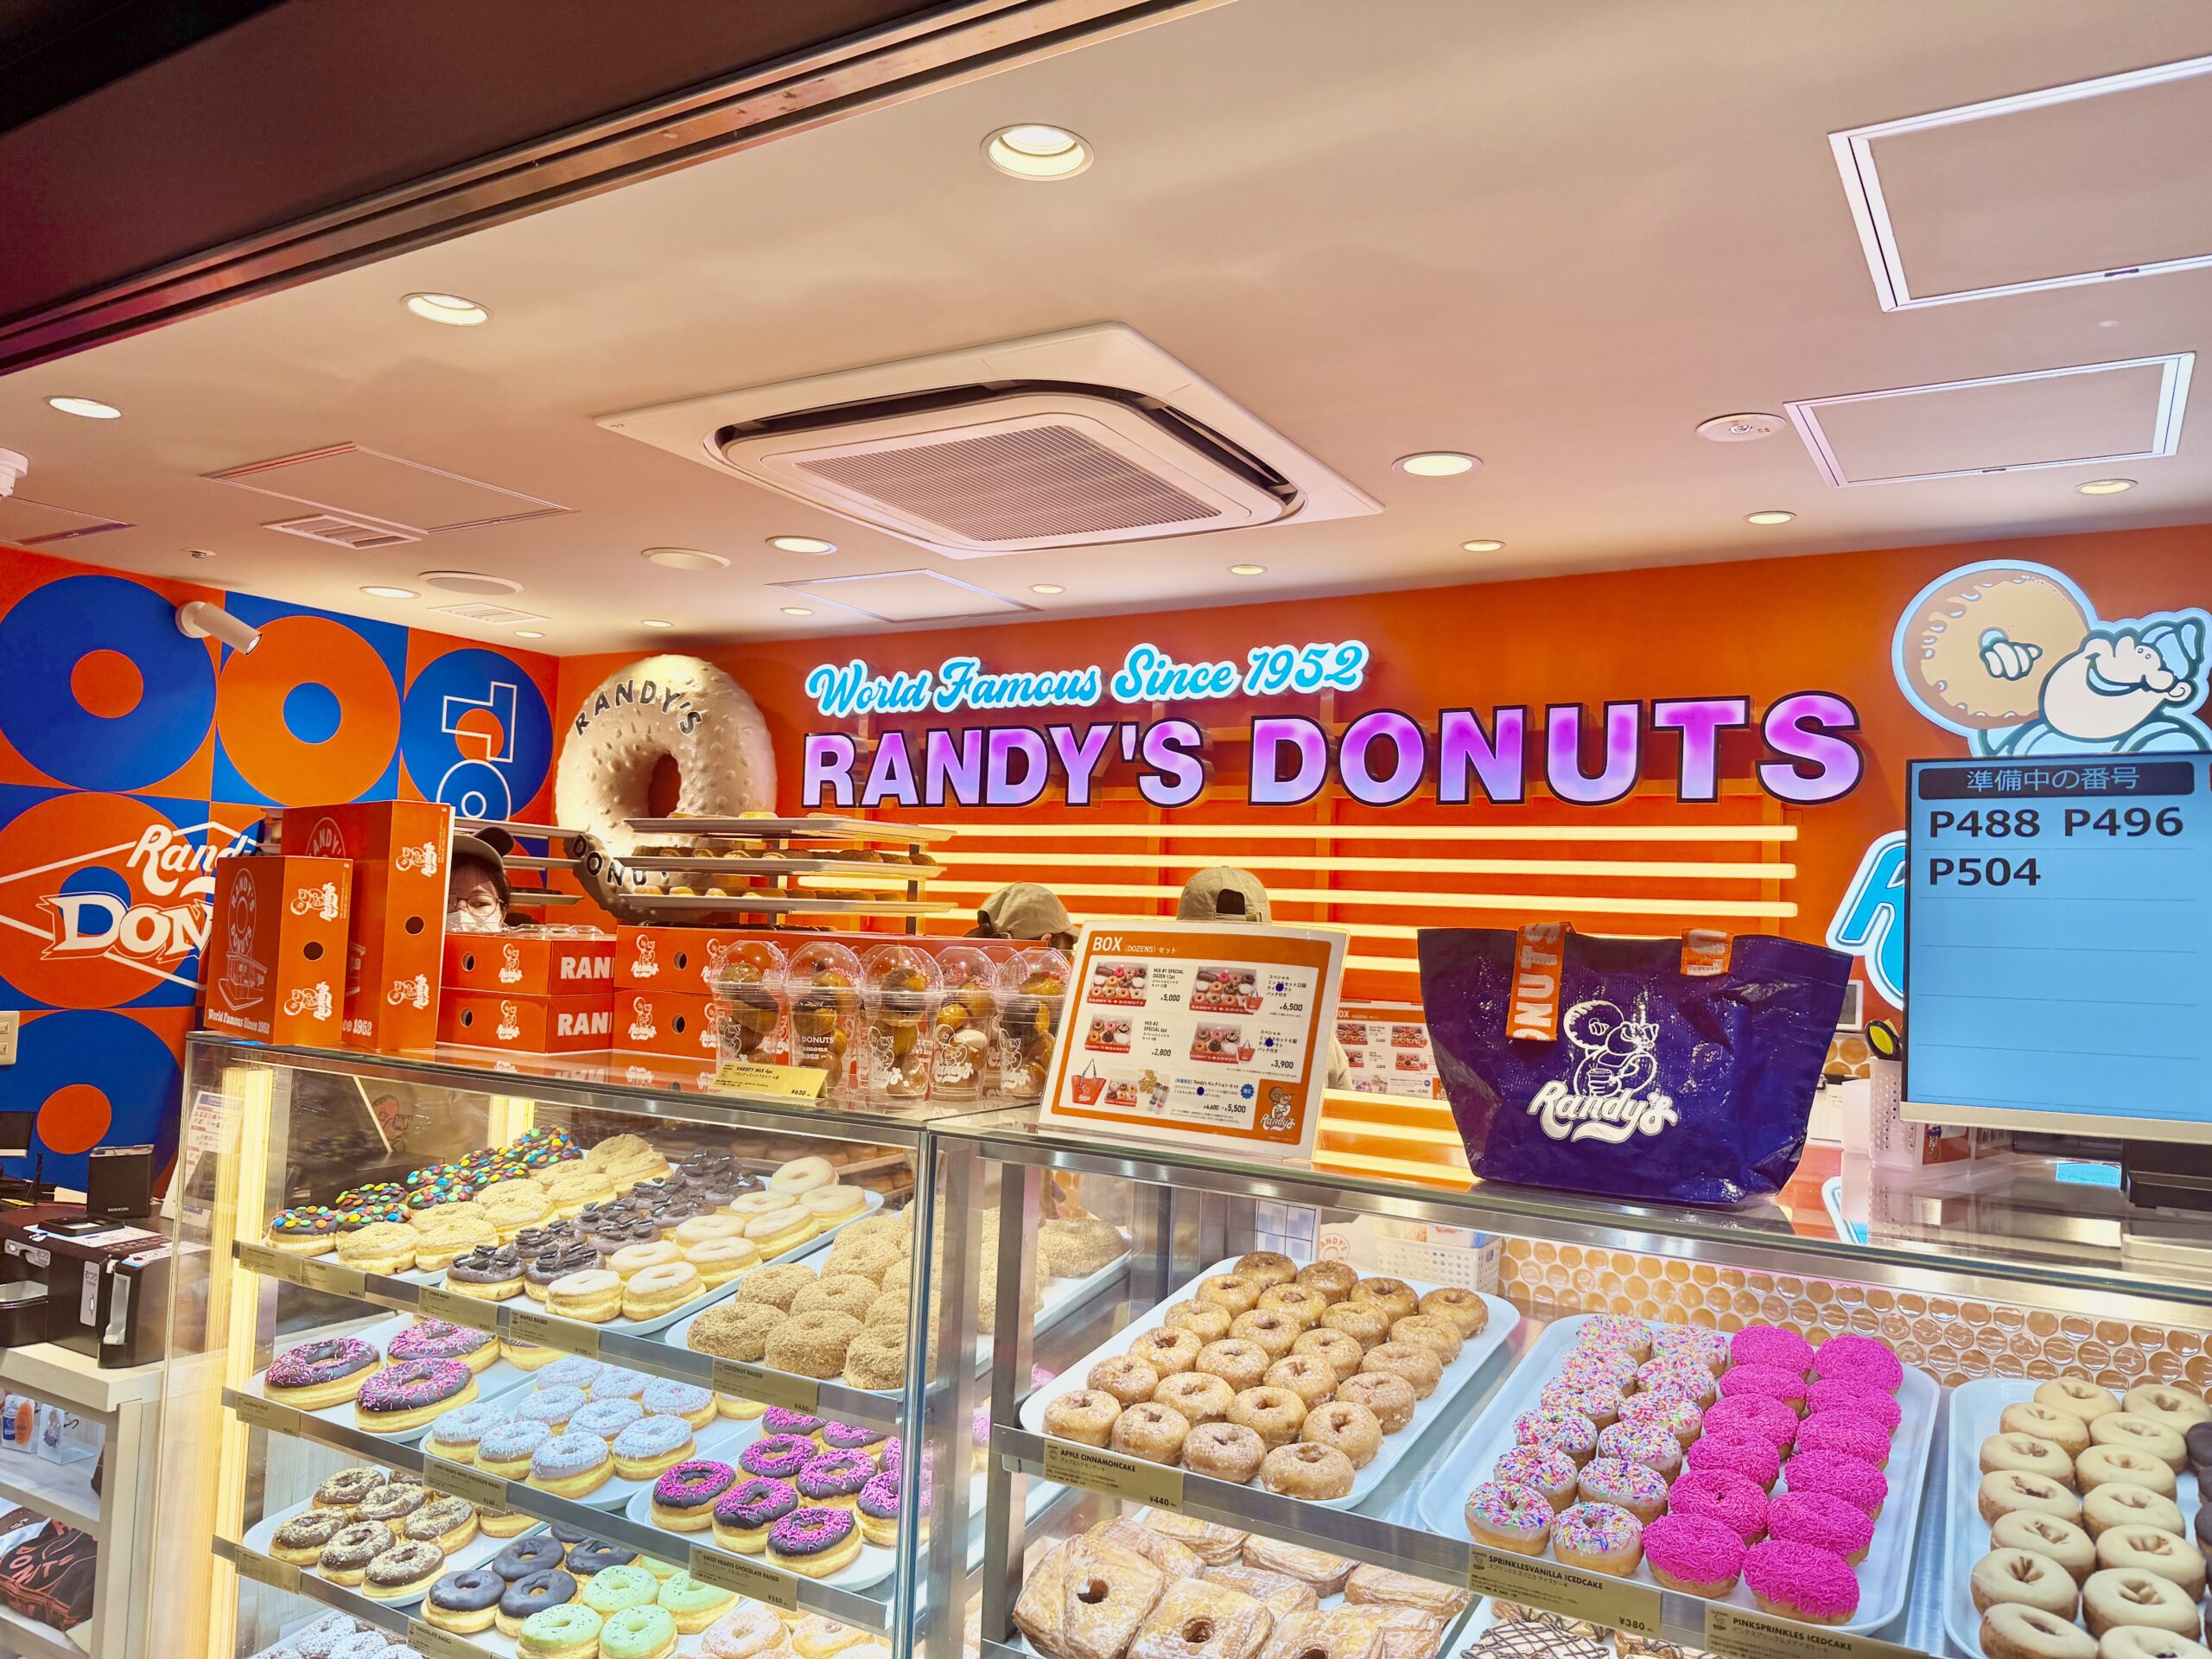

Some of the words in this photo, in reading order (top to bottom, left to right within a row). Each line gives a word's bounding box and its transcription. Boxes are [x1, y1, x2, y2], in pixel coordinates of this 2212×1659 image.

[804, 659, 932, 718] World
[933, 656, 1102, 714] Famous
[1111, 642, 1240, 704] Since
[1243, 639, 1370, 696] 1952
[575, 679, 702, 735] RANDY'S
[801, 718, 1205, 809] RANDY'S
[1248, 690, 1864, 805] DONUTS
[1967, 766, 2140, 792] 準備中の番号
[1929, 809, 2040, 838] P488
[2064, 807, 2183, 836] P496
[1929, 857, 2041, 886] P504
[1092, 936, 1122, 952] BOX
[1125, 944, 1155, 954] (DOZENS)
[561, 956, 614, 979] RAN
[1280, 1003, 1303, 1012] ¥6,500
[224, 1012, 244, 1028] Famous
[244, 1016, 257, 1031] Since
[257, 1020, 270, 1034] 1952
[353, 1018, 372, 1036] 1952
[557, 1011, 612, 1036] RAN
[1151, 1048, 1172, 1057] ¥2,800
[1270, 1059, 1294, 1069] ¥3,900
[1260, 1113, 1296, 1131] Randy's
[1527, 1079, 1678, 1143] Randy's
[1319, 1236, 1348, 1252] ANDY'S
[85, 1270, 99, 1281] おつり
[724, 1364, 747, 1375] COCONUT
[747, 1370, 764, 1379] RAISED
[1060, 1449, 1079, 1459] APPLE
[1080, 1453, 1136, 1472] CINNAMONCAKE
[1149, 1495, 1169, 1507] ¥440
[703, 1554, 718, 1564] SWEET
[717, 1559, 734, 1568] HEARTS
[735, 1564, 762, 1578] CHOCOLATE
[762, 1572, 779, 1583] RAISED
[1489, 1555, 1562, 1580] SPRINKLESVANILLA
[1564, 1573, 1604, 1590] ICEDCAKE
[416, 1624, 438, 1638] CHOCOLATE
[1618, 1617, 1645, 1631] ¥380
[1732, 1617, 1805, 1642] PINKSPRINKLES
[1807, 1634, 1853, 1652] ICEDCAKE
